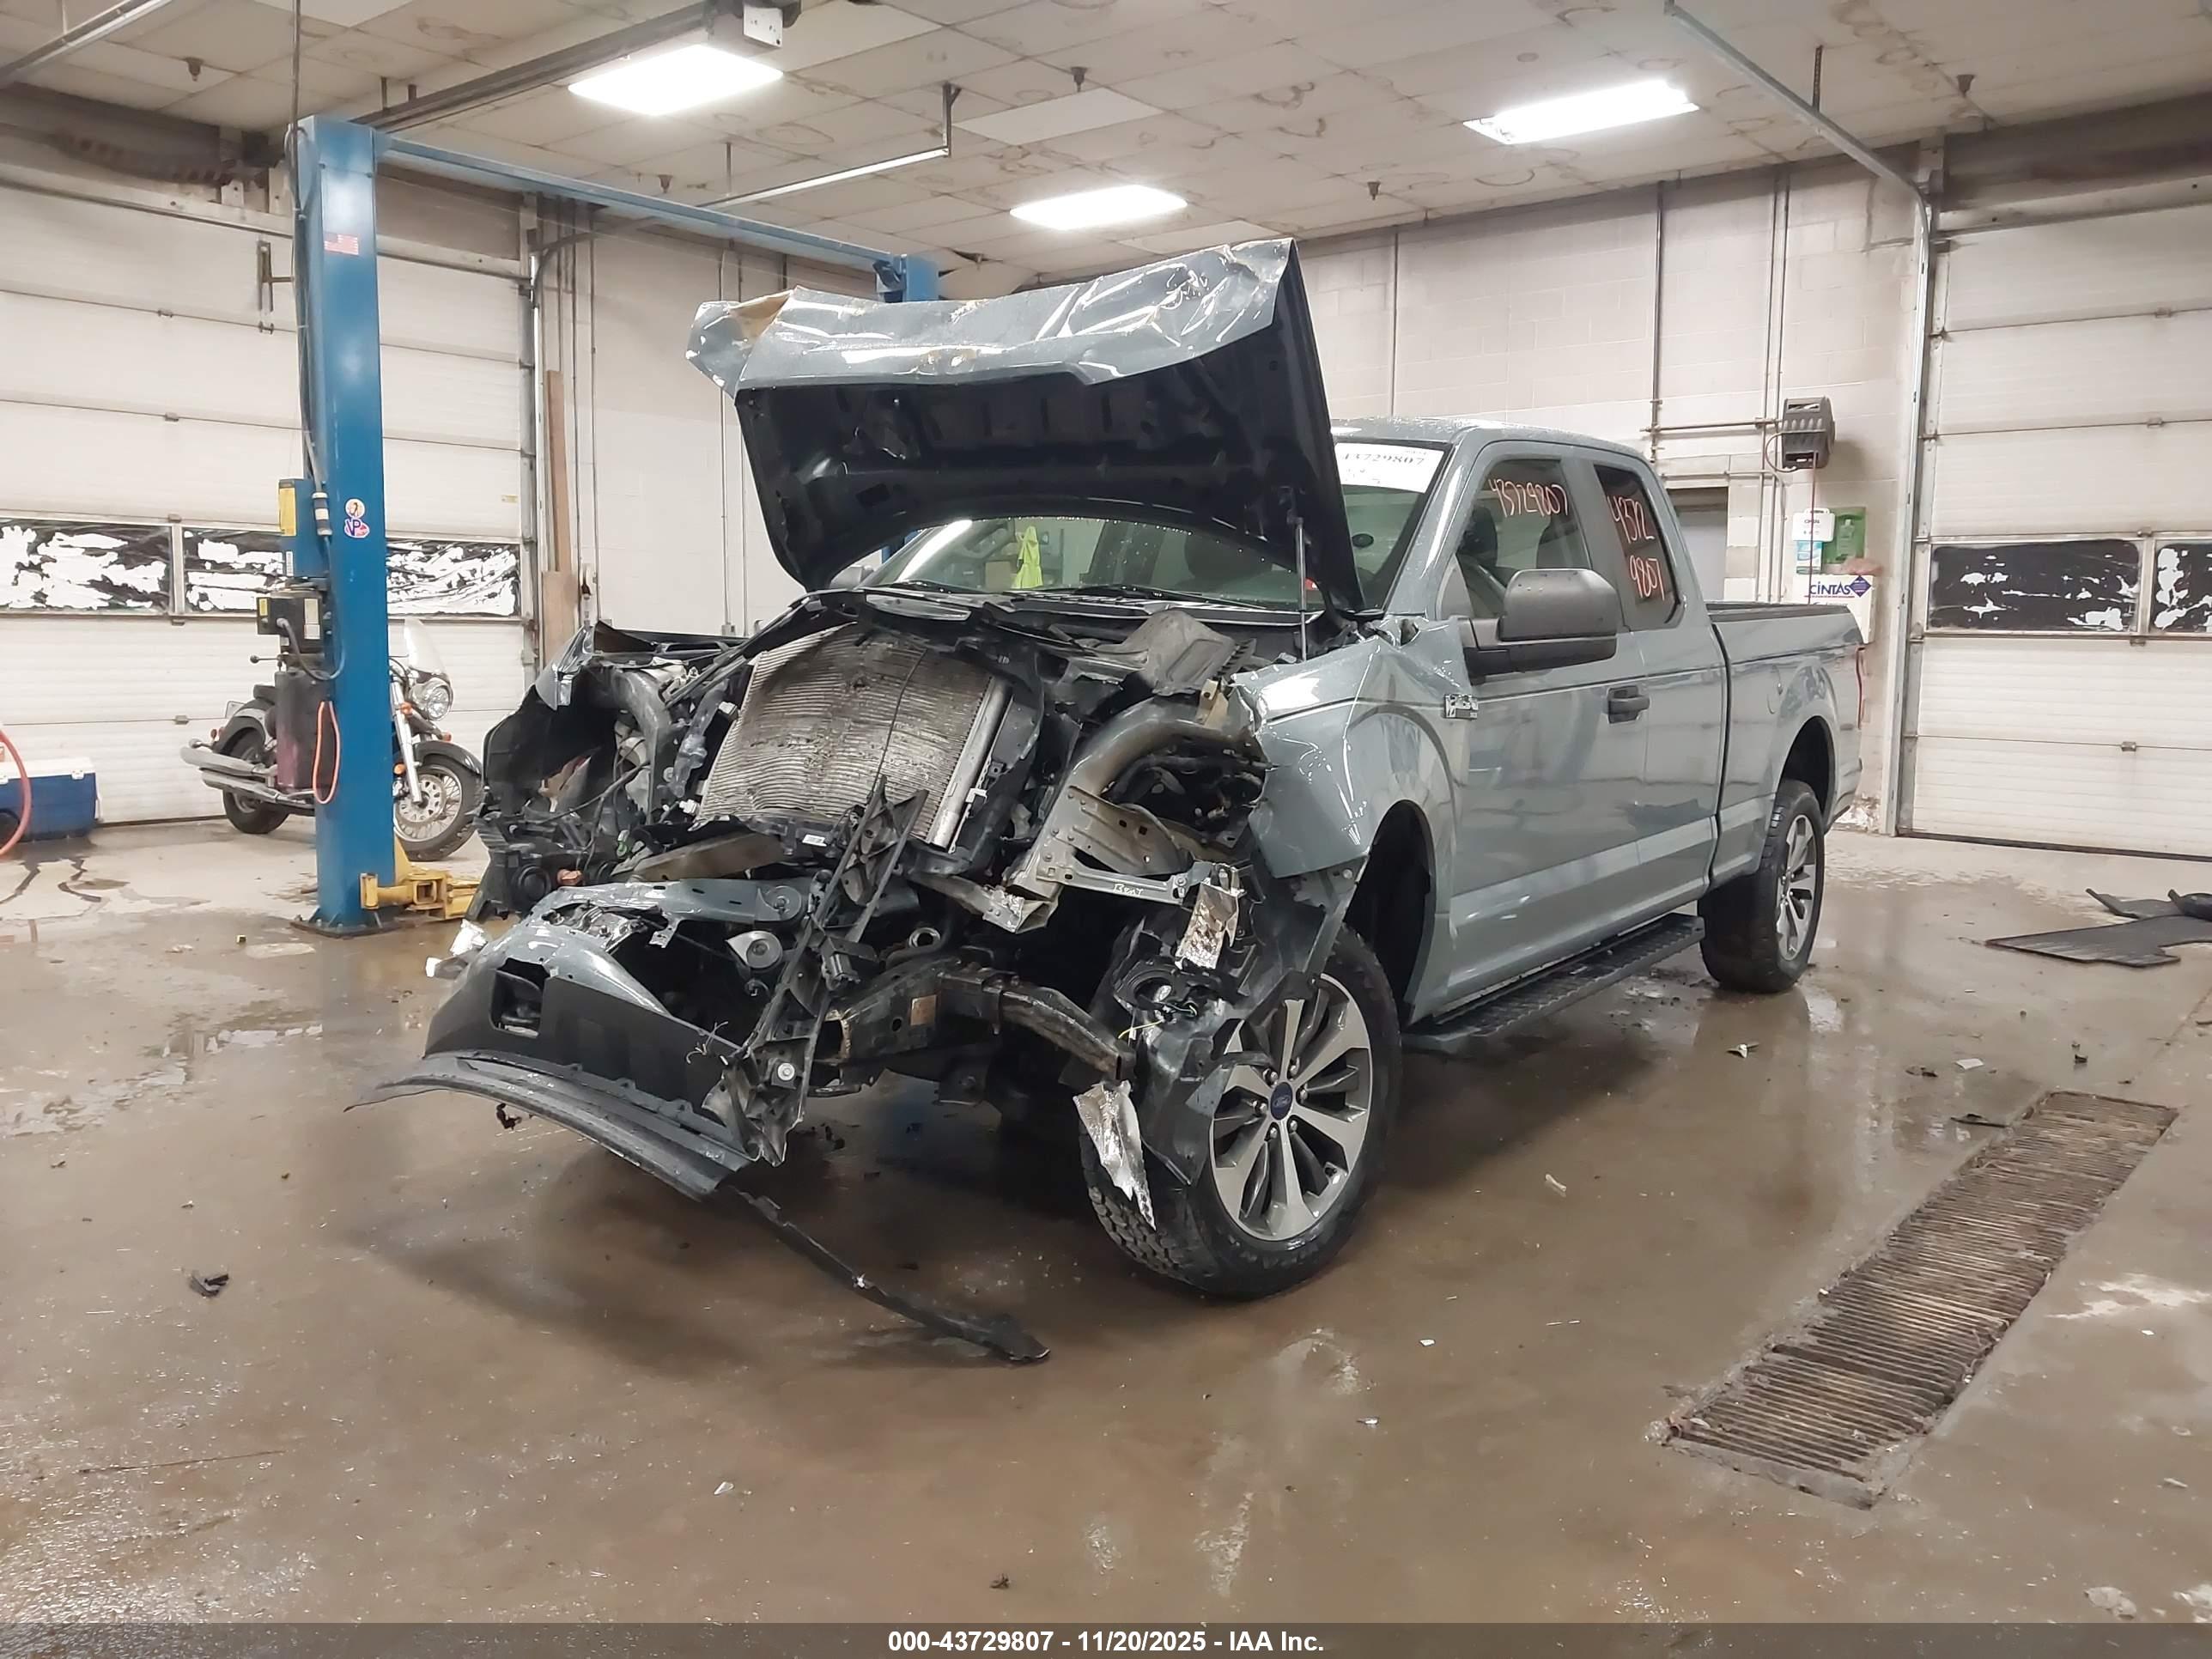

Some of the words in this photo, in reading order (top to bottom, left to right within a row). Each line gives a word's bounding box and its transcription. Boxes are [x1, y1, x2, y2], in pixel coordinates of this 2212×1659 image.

[1488, 478, 1568, 518] 43729807
[1607, 495, 1656, 544] 4372
[1629, 554, 1665, 601] 9807
